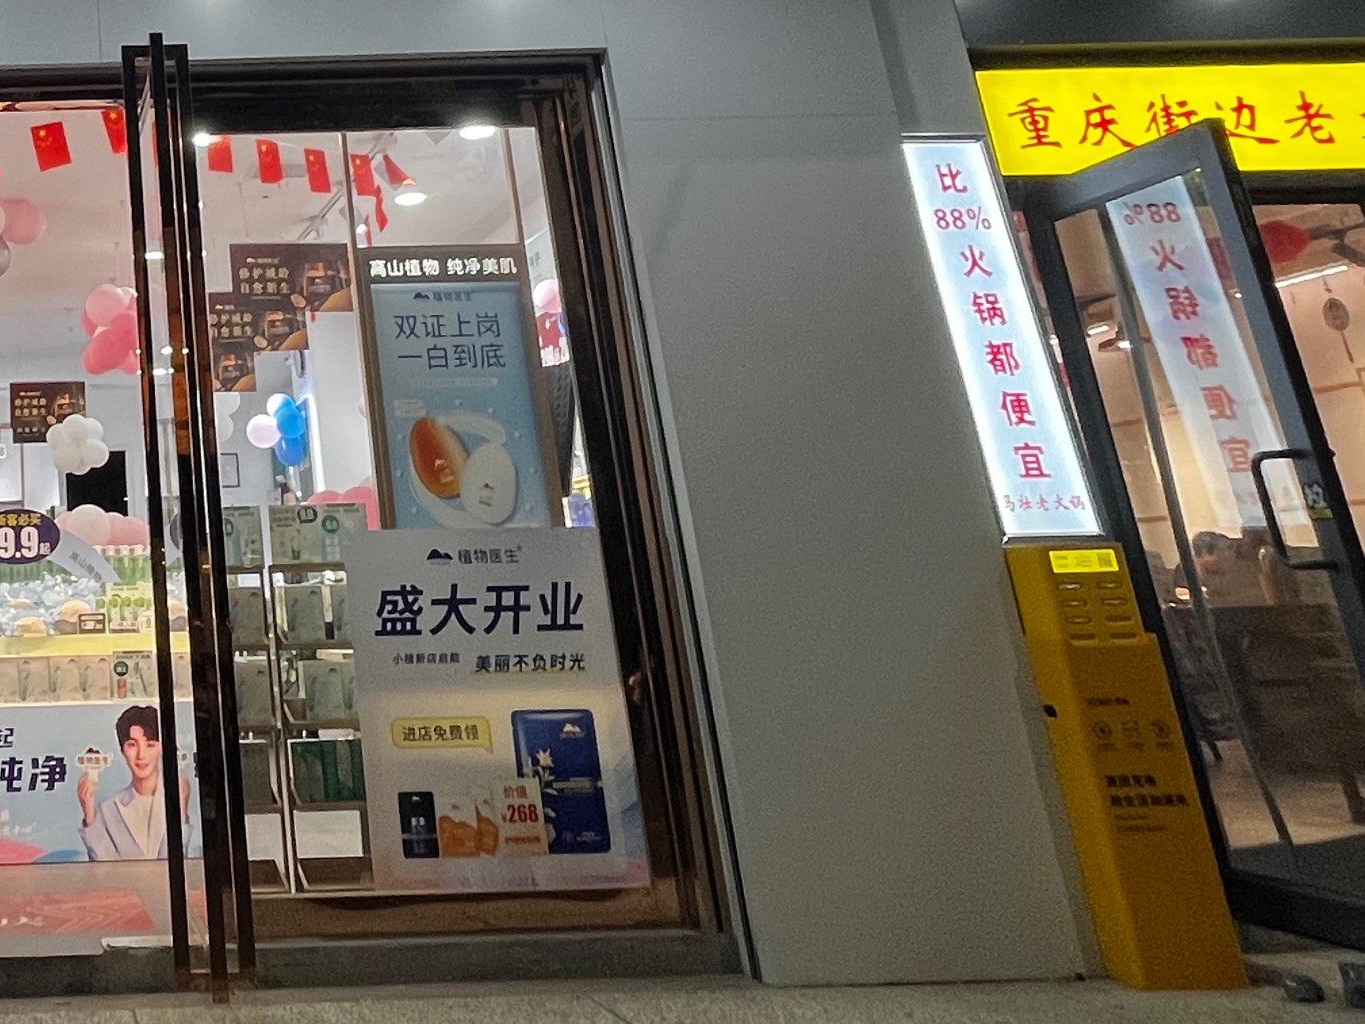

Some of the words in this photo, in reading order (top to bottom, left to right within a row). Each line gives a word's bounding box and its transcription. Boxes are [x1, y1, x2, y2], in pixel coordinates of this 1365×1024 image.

[1007, 90, 1365, 150] 重庆街边老
[369, 259, 439, 277] 高山植物
[446, 257, 517, 275] 纯净美肌
[393, 312, 501, 339] 双证上岗
[397, 344, 506, 370] 一白到底
[458, 548, 520, 564] 植物医生
[375, 581, 584, 637] 盛大开业
[475, 652, 586, 674] 美丽不负时光
[402, 724, 480, 743] 进店免费领
